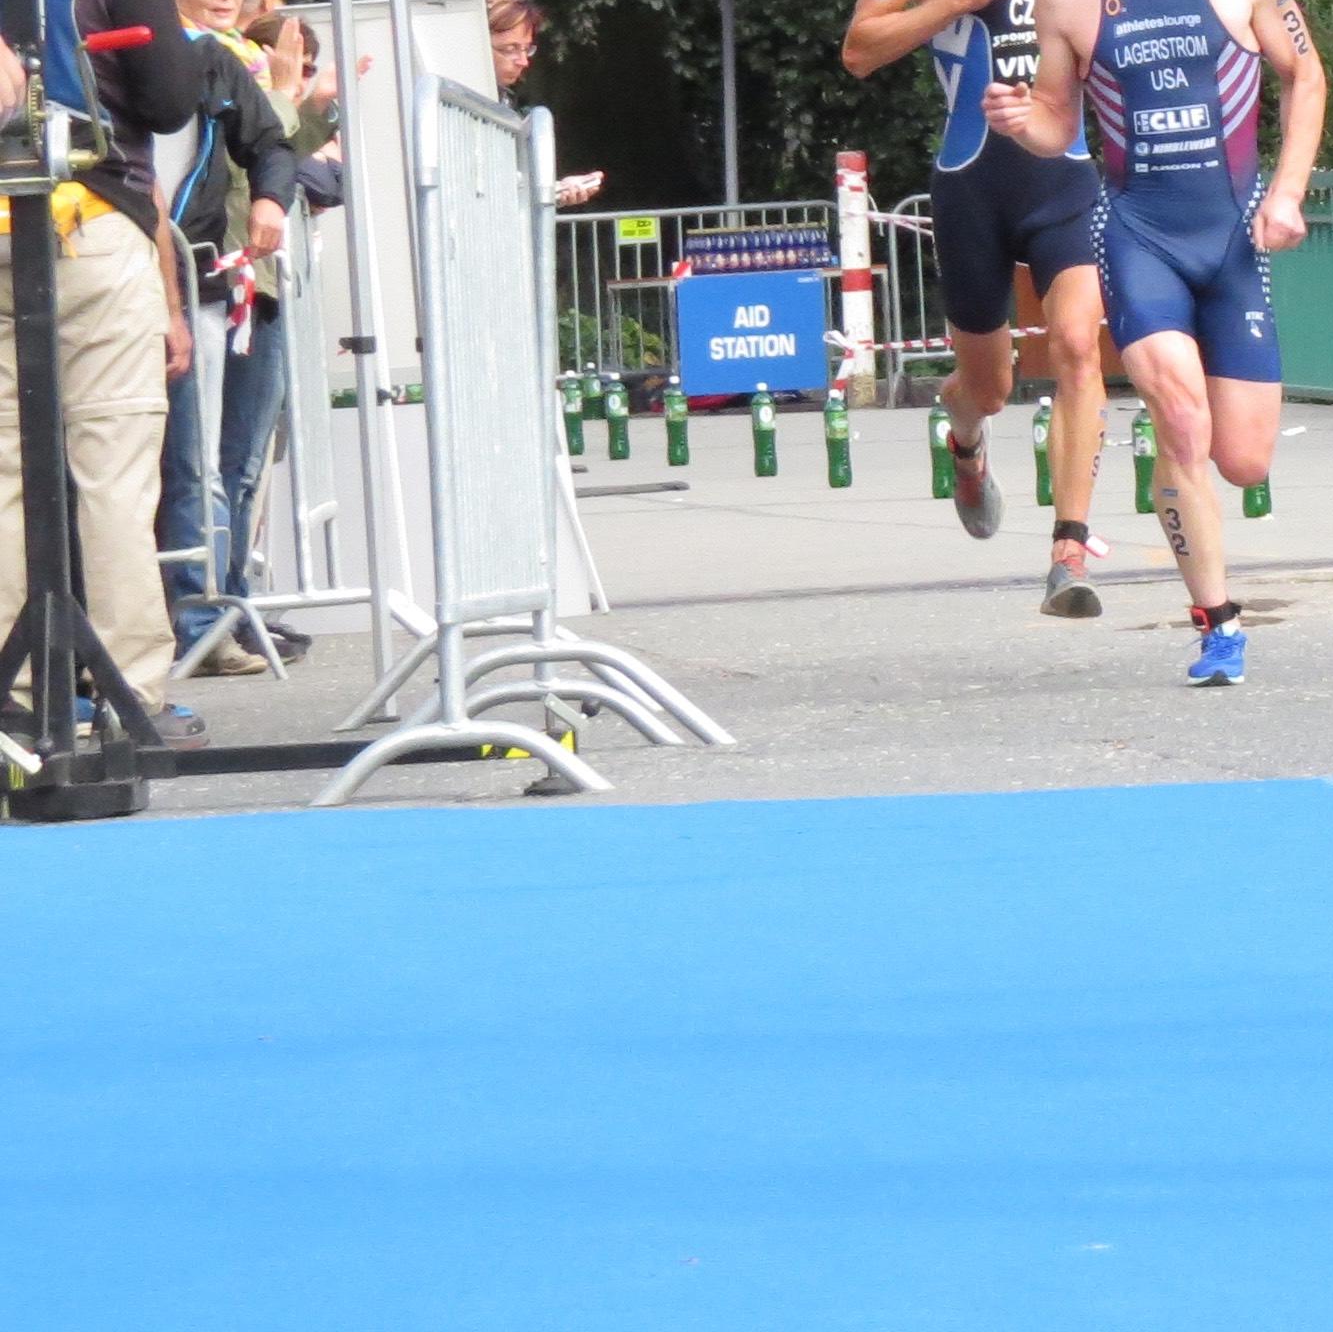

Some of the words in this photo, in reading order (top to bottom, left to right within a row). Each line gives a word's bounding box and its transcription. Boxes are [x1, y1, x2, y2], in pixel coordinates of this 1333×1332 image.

[1282, 10, 1309, 55] 32
[1115, 35, 1209, 68] LAGERSTROM
[1150, 67, 1189, 91] USA
[1149, 108, 1206, 131] CLIF
[733, 304, 770, 329] AID
[710, 333, 796, 361] STATION
